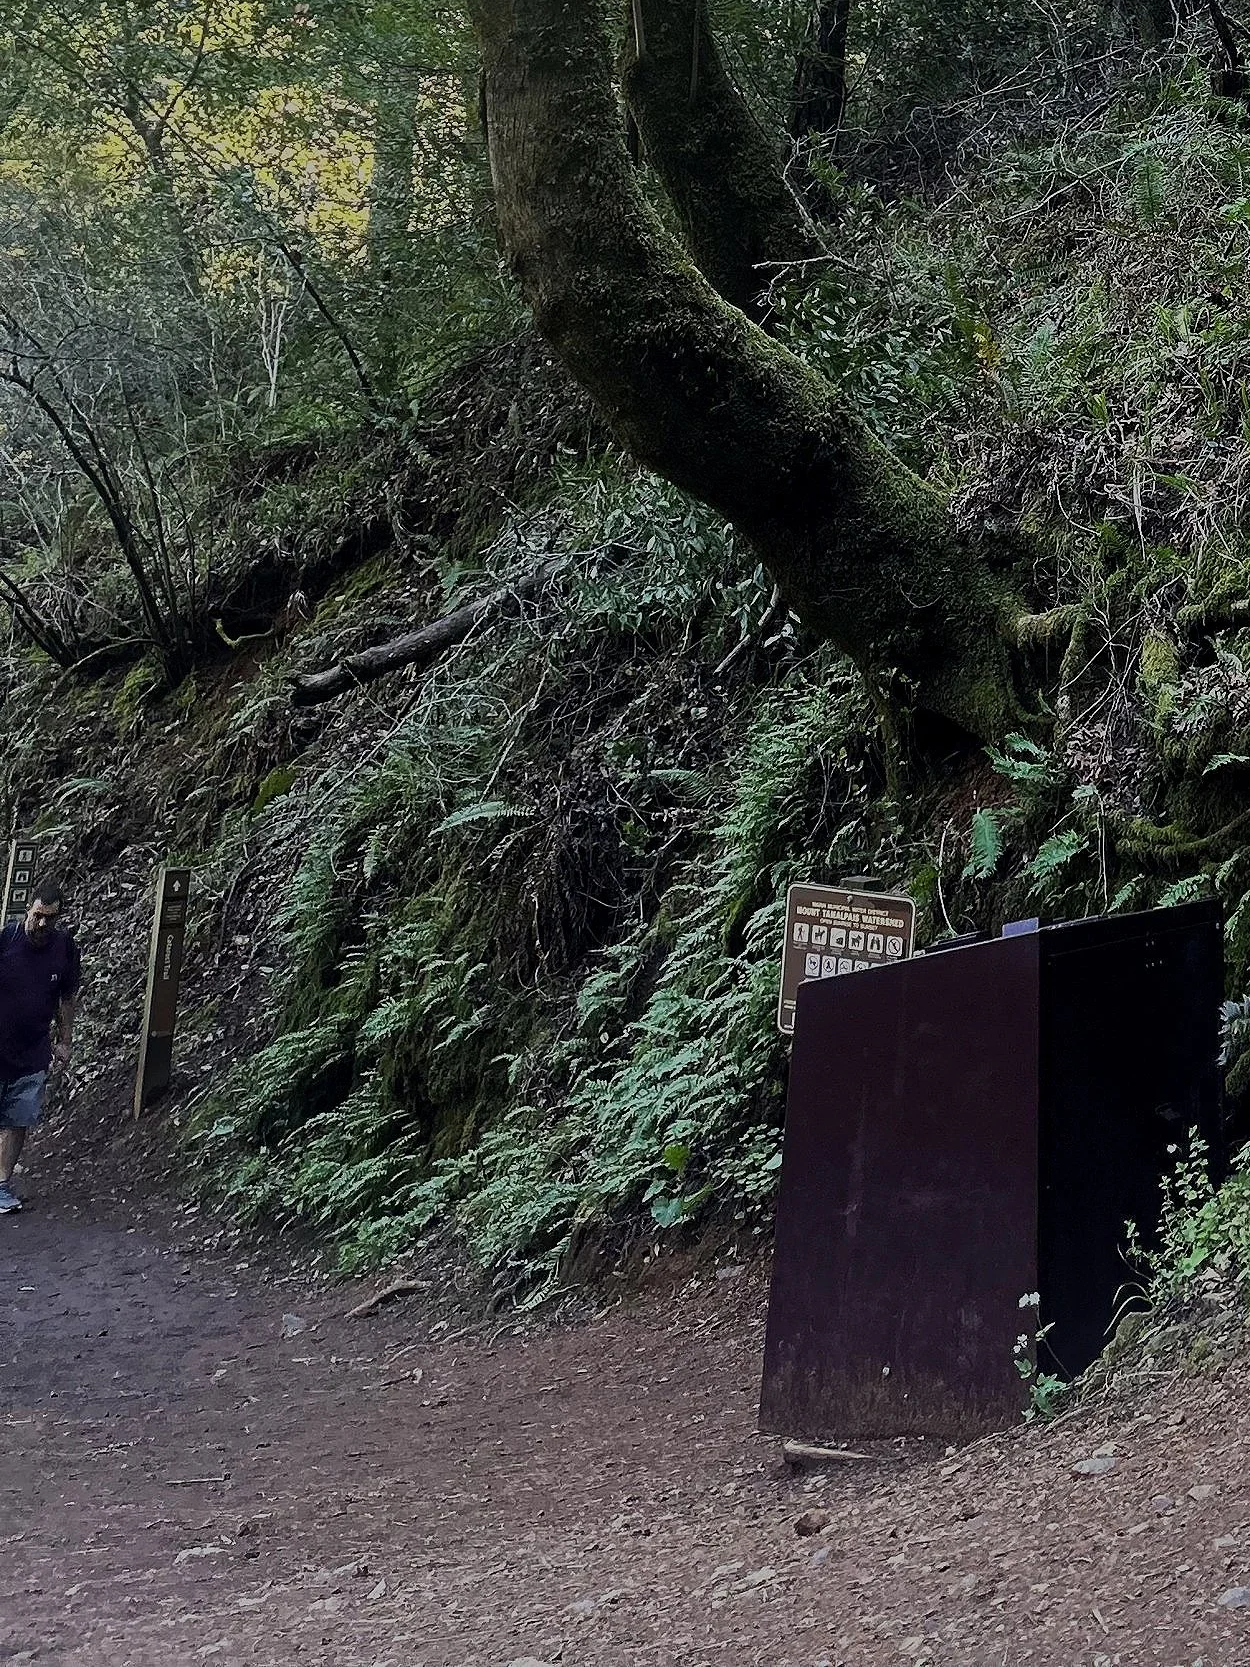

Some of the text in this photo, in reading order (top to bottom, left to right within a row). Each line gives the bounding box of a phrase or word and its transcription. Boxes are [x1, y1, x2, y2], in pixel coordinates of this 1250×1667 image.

[796, 906, 821, 917] MOUNT
[822, 909, 860, 922] TAMALPAIS
[861, 915, 904, 929] WATERSHED
